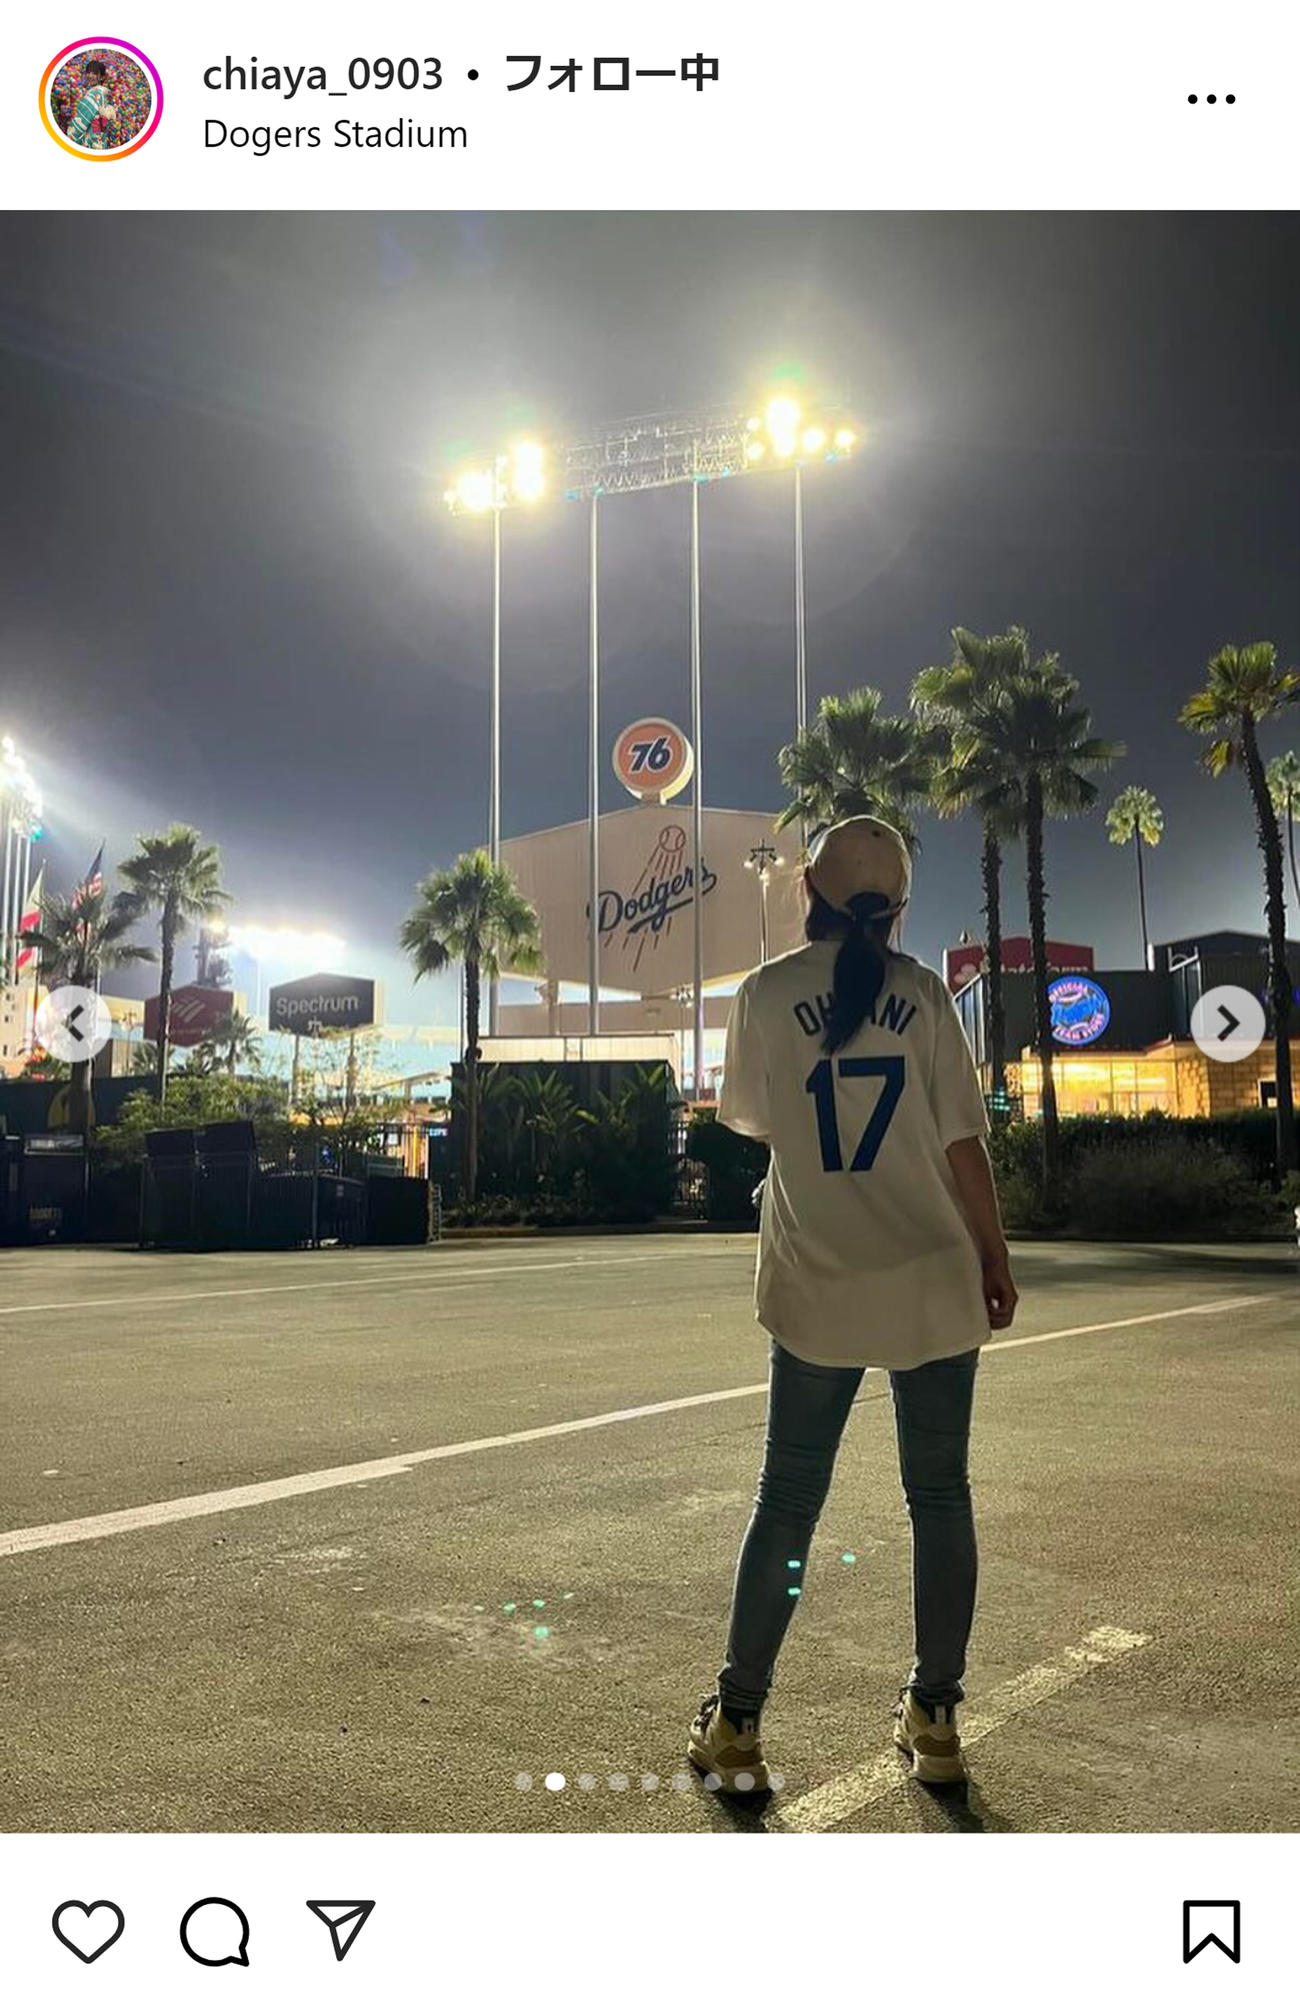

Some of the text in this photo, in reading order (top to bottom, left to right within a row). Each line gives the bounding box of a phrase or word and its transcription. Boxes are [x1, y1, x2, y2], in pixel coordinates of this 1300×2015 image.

[629, 736, 673, 774] 76
[586, 857, 717, 934] Dodgers
[276, 994, 359, 1019] Spectrum
[806, 1055, 906, 1173] 17
